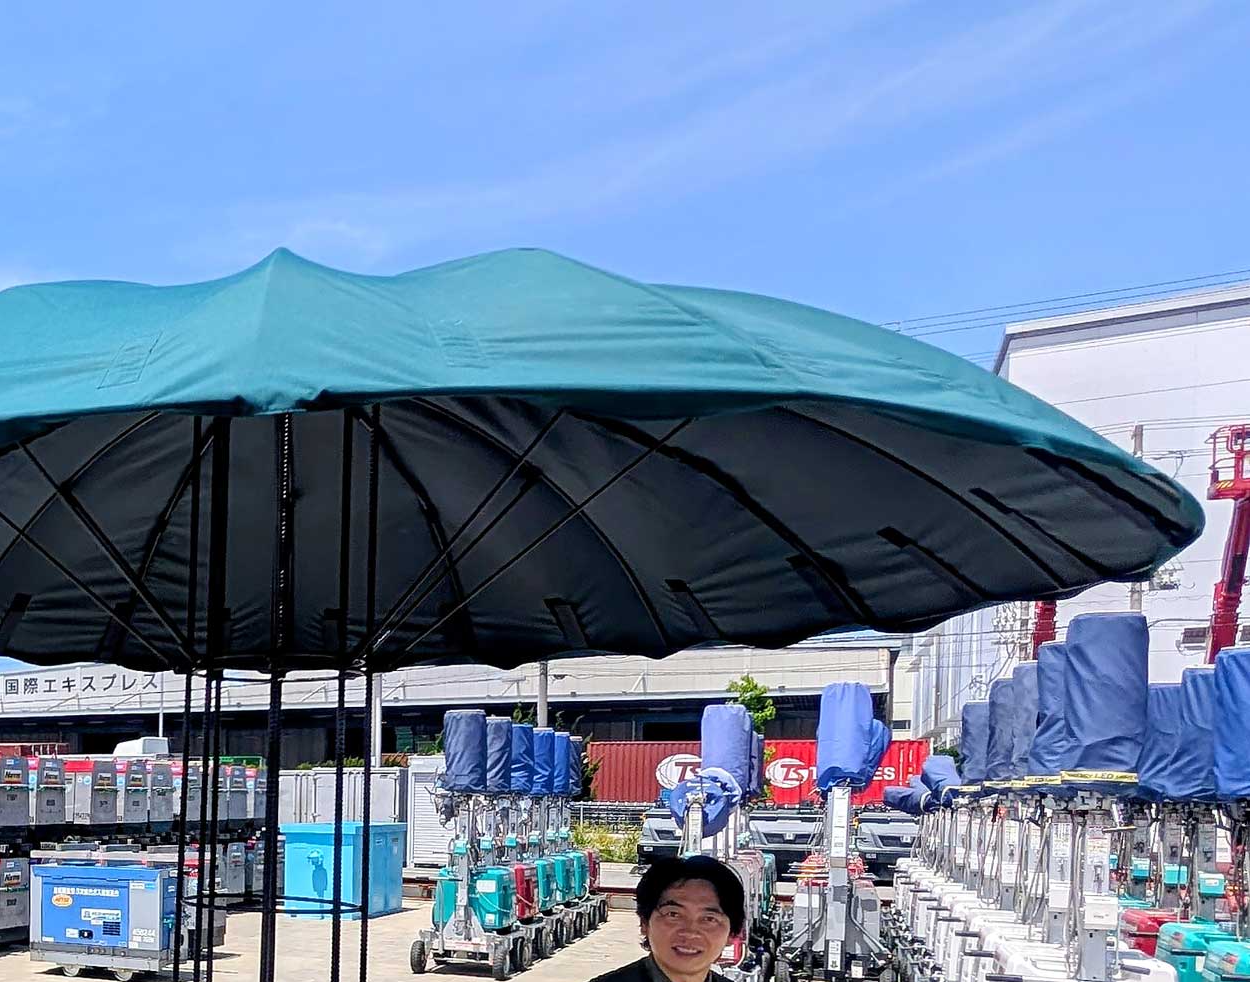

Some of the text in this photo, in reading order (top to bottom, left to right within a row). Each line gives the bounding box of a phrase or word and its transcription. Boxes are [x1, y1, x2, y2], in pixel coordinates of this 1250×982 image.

[4, 673, 159, 696] 国際エキスプレス
